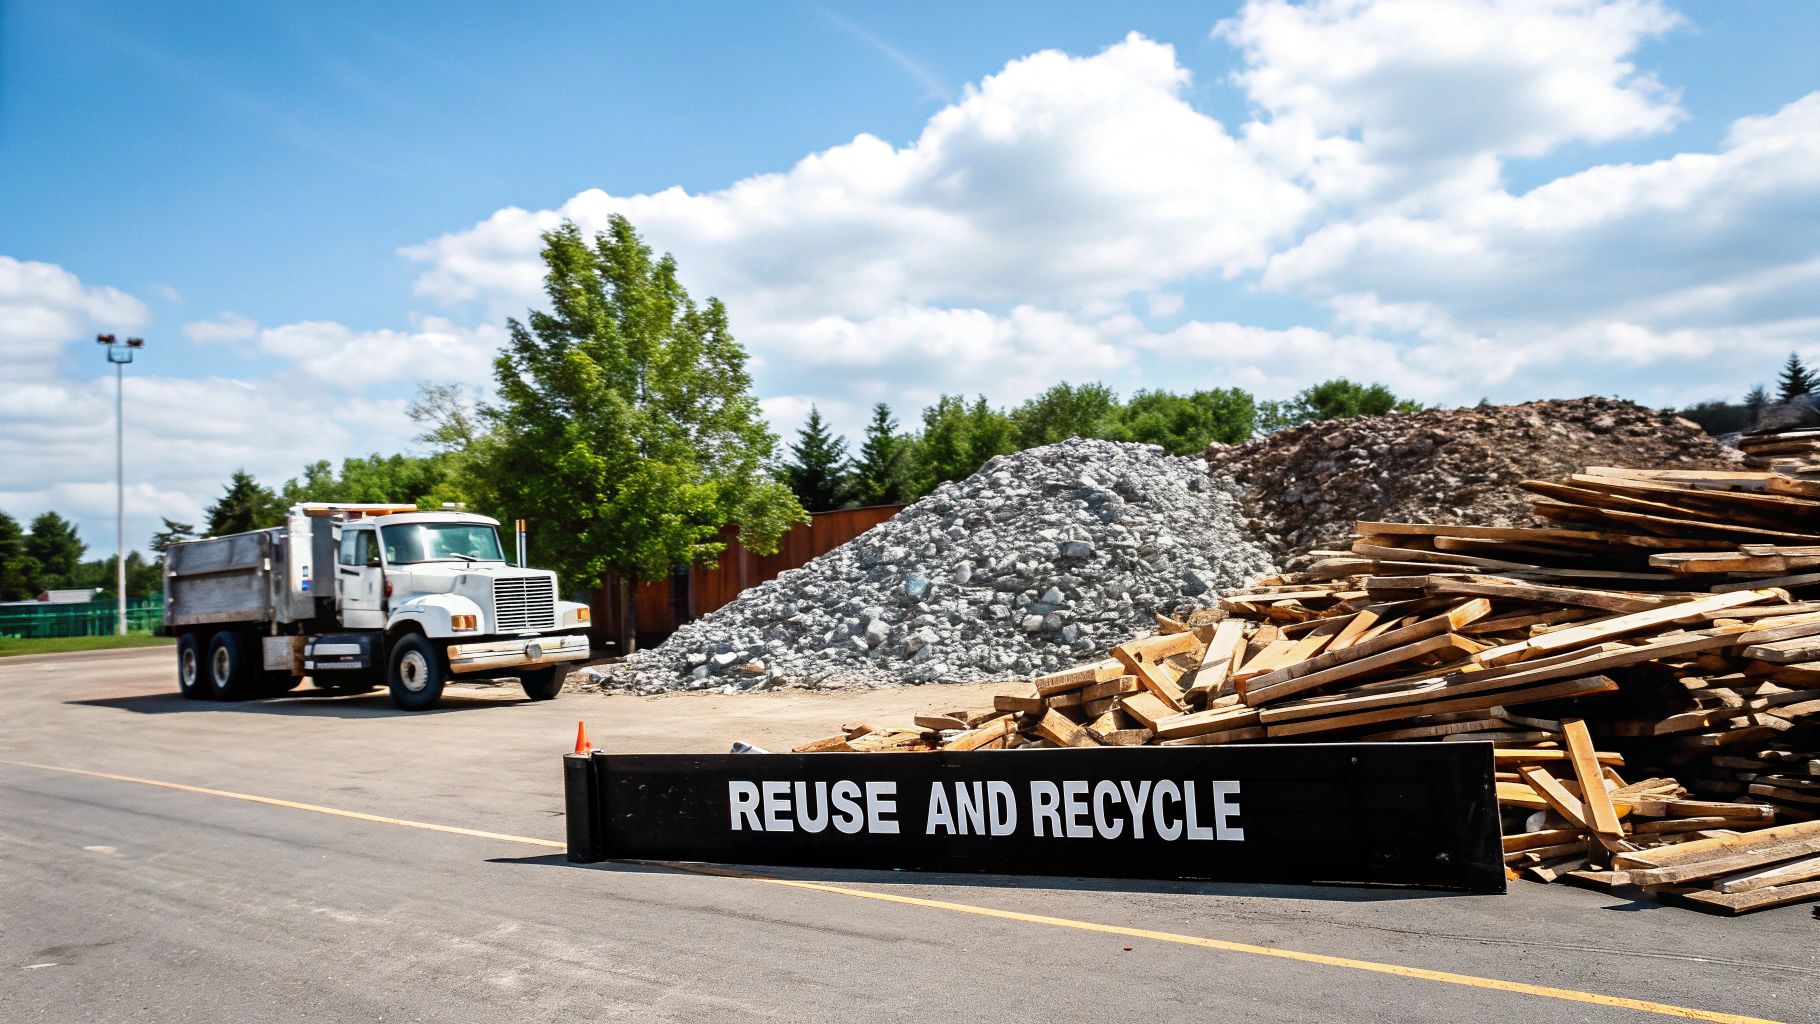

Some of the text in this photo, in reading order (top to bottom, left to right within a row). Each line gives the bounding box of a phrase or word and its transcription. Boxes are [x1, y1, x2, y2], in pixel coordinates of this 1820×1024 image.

[728, 779, 1245, 841] REUSE AND RECYCLE
